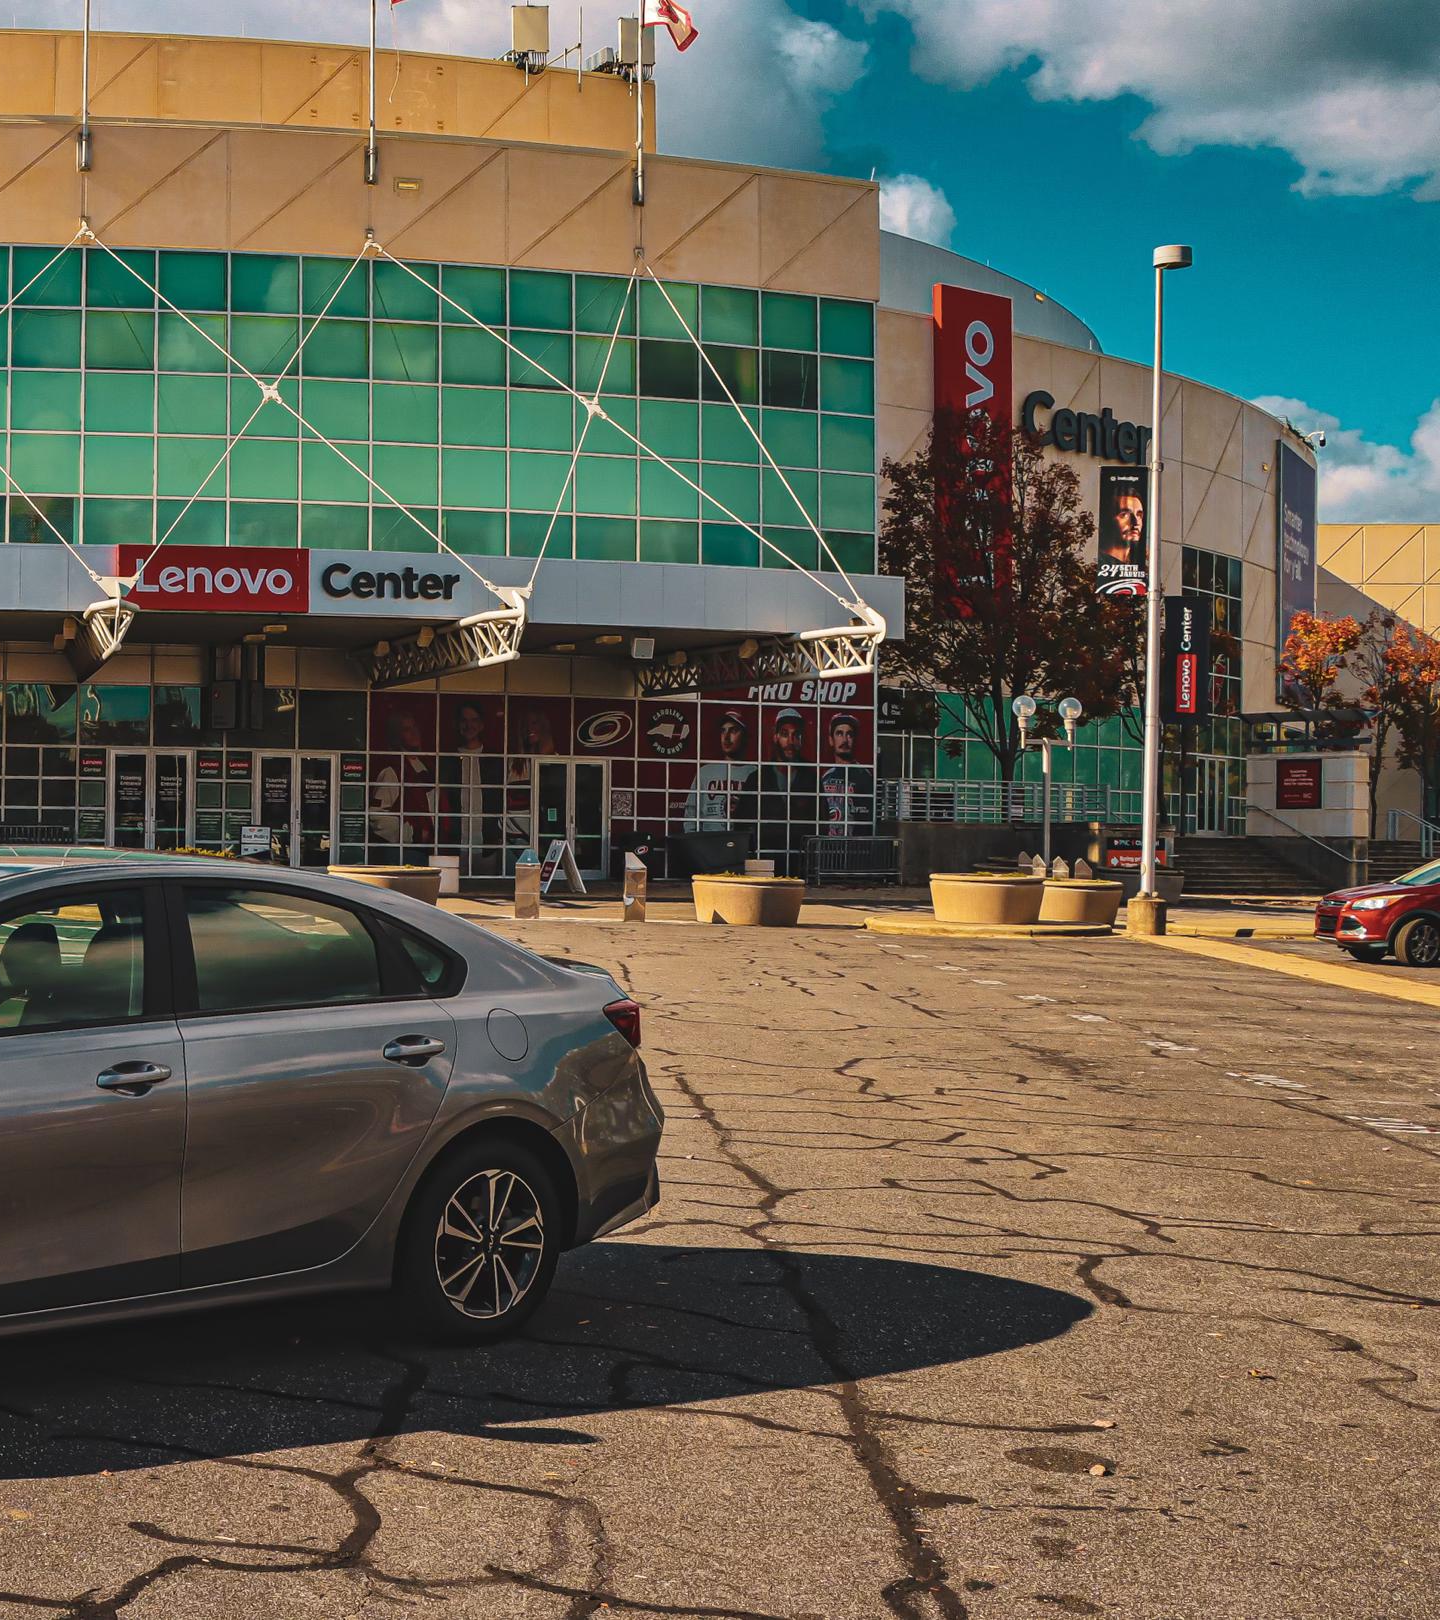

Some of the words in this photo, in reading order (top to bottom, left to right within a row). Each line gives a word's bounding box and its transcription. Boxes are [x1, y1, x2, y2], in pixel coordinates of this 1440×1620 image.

[135, 558, 293, 595] Lenovo
[322, 562, 460, 600] Center
[1097, 564, 1119, 578] 24
[1180, 606, 1193, 651] Center
[800, 680, 857, 703] SHOP
[1179, 659, 1191, 709] Lenovo
